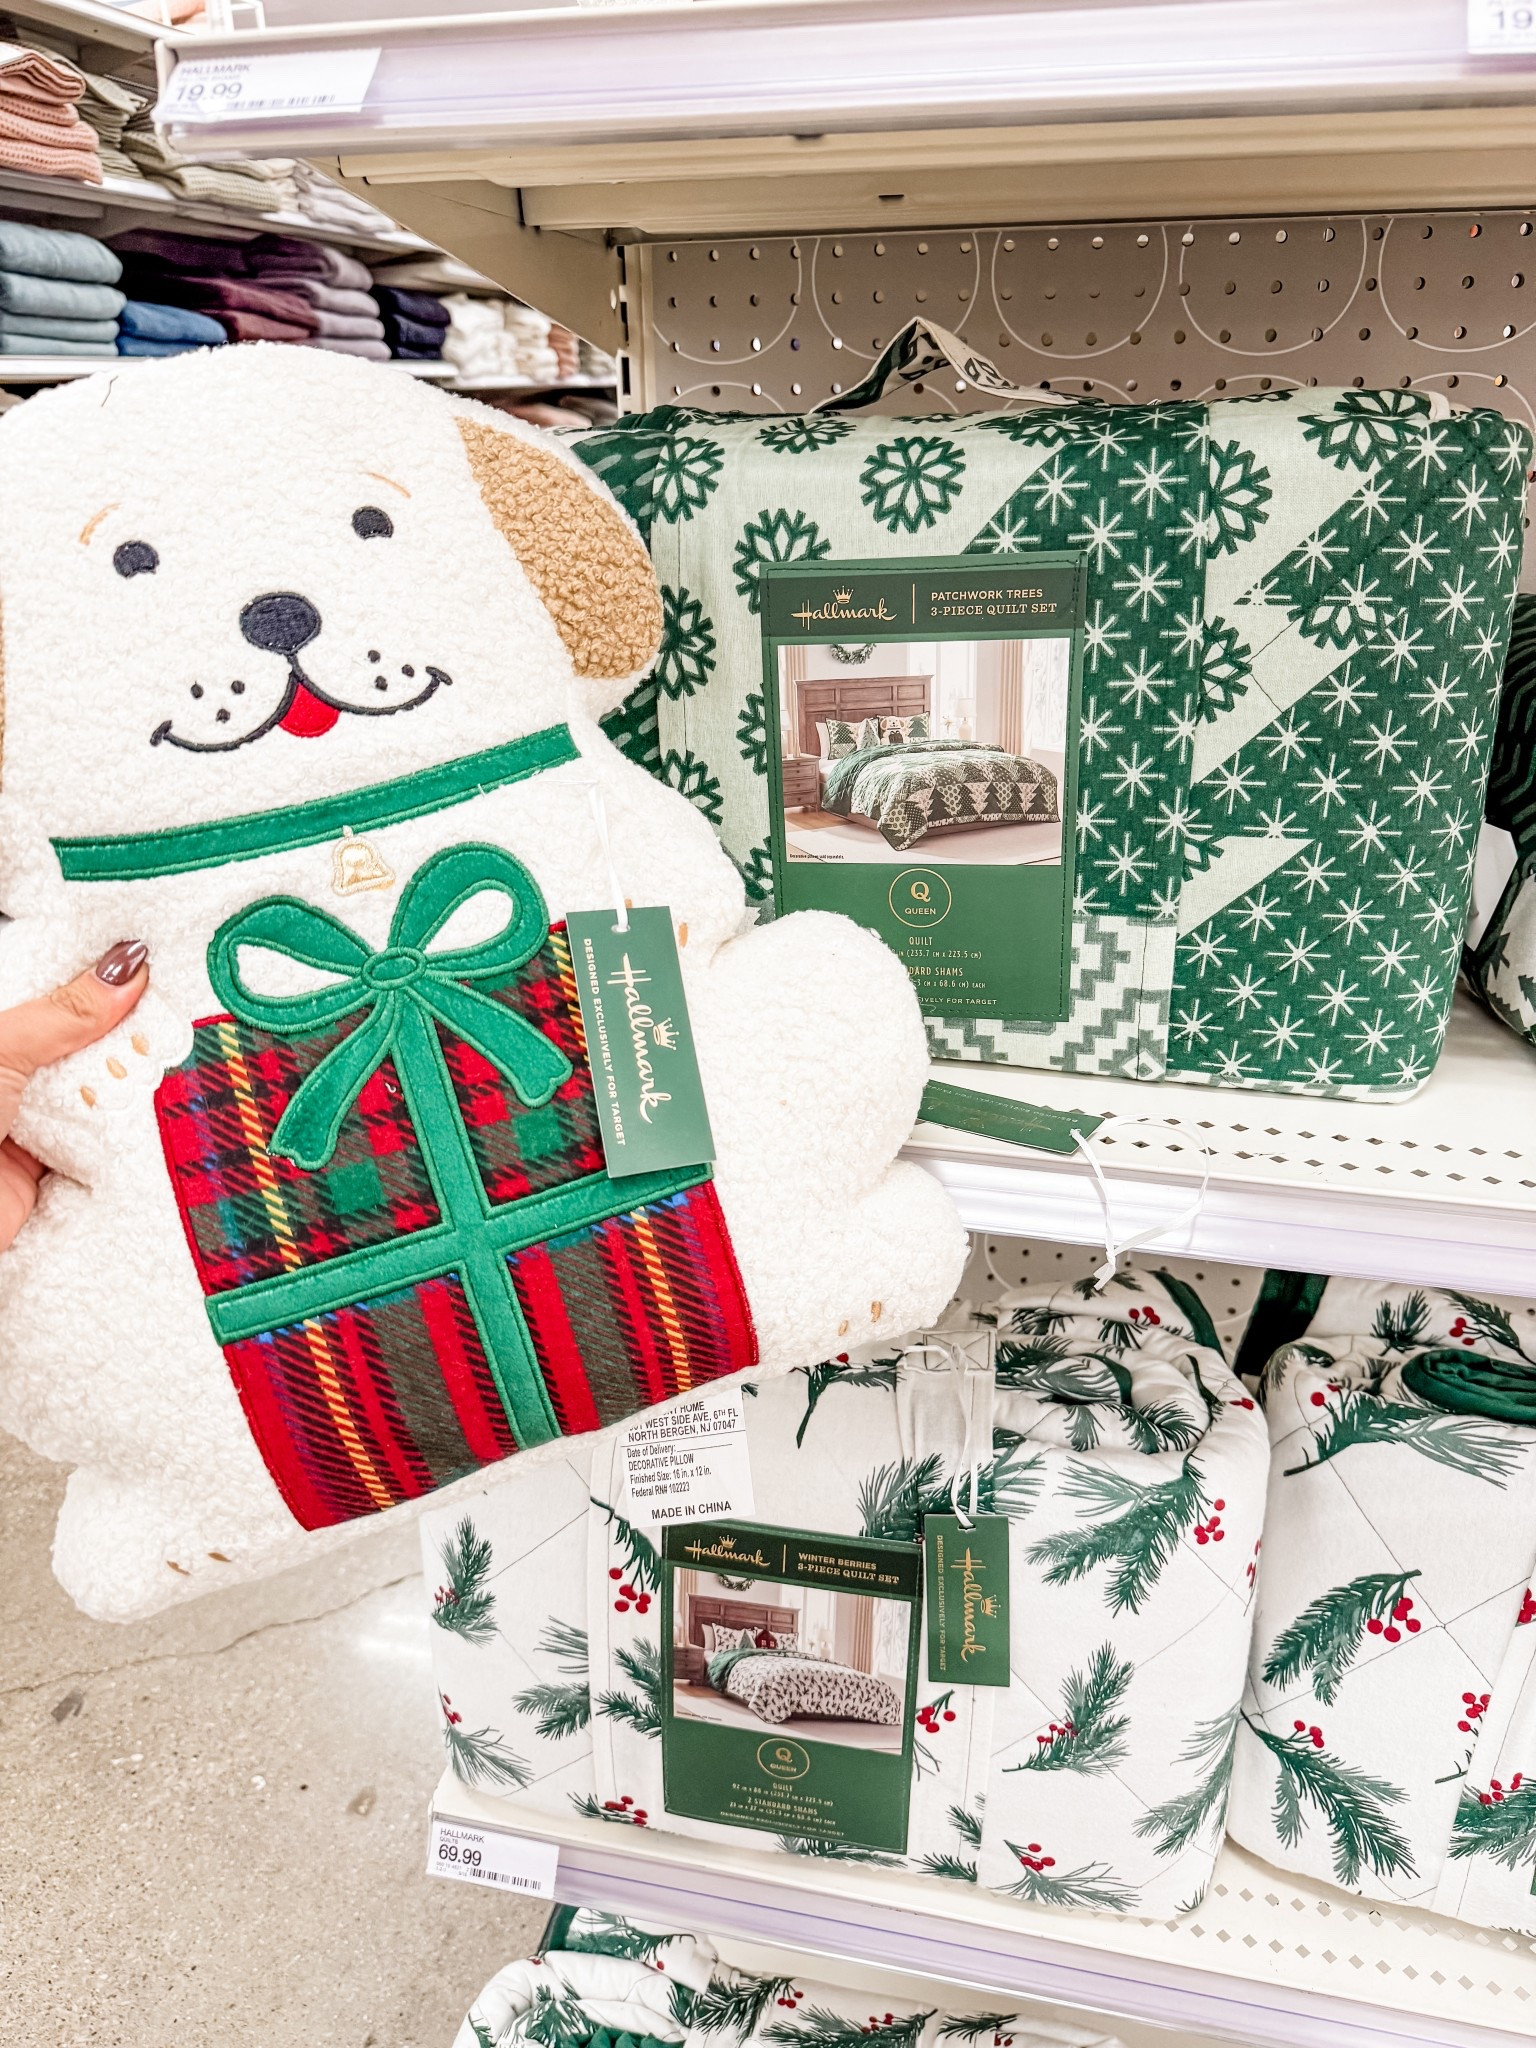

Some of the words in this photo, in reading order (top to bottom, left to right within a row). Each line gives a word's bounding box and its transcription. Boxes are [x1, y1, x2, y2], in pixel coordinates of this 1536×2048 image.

[180, 64, 252, 76] HALLMARK
[176, 82, 244, 102] 19.99
[931, 591, 1003, 601] PATCHWORK
[1007, 588, 1044, 599] TREES
[791, 598, 897, 630] Hallmark
[931, 605, 983, 617] 3-PIECE
[986, 604, 1028, 616] QUILT
[1031, 602, 1057, 614] SET
[910, 881, 931, 902] Q
[909, 936, 933, 947] QUILT
[948, 950, 968, 958] 223.5
[583, 938, 600, 995] DESIGNED
[935, 967, 963, 977] SHAMS
[939, 979, 956, 988] 68.6
[593, 997, 613, 1073] EXCLUSIVELY
[607, 952, 673, 1124] Hallmark
[606, 1075, 618, 1099] FOR
[609, 1100, 626, 1147] TARGET
[680, 1401, 705, 1414] HOME
[645, 1417, 669, 1429] WEST
[671, 1414, 692, 1426] SIDE
[693, 1412, 712, 1423] AVE,
[713, 1409, 726, 1420] 6TH
[728, 1408, 739, 1418] FL
[628, 1430, 658, 1443] NORTH
[660, 1425, 699, 1438] BERGEN,
[700, 1423, 711, 1433] NJ
[713, 1419, 736, 1431] 07047
[627, 1448, 641, 1458] Date
[642, 1447, 649, 1457] of
[649, 1444, 676, 1456] Delivery:
[628, 1456, 669, 1471] DECORATIVE
[670, 1453, 694, 1466] PILLOW
[630, 1473, 656, 1485] Finished
[656, 1471, 672, 1481] Size:
[673, 1469, 680, 1480] 16
[681, 1468, 690, 1478] in.
[695, 1466, 702, 1476] 12
[703, 1465, 712, 1475] in.
[631, 1486, 654, 1498] Federal
[655, 1484, 668, 1495] RN#
[669, 1482, 690, 1494] 102223
[651, 1506, 682, 1519] MADE
[685, 1505, 695, 1516] IN
[698, 1501, 732, 1514] CHINA
[684, 1538, 771, 1567] Hallmark
[798, 1552, 835, 1565] WINTER
[838, 1558, 877, 1570] BERRIES
[936, 1535, 944, 1573] DESIGNED
[797, 1562, 841, 1577] 3-PIECE
[842, 1569, 876, 1581] QUILT
[878, 1574, 900, 1584] SET
[937, 1575, 945, 1629] EXCLUSIVELY
[950, 1547, 987, 1663] Hallmark
[775, 1747, 793, 1763] Q
[772, 1782, 793, 1792] QUILT
[440, 1828, 485, 1843] HALLMARK
[438, 1844, 482, 1866] 69.99
